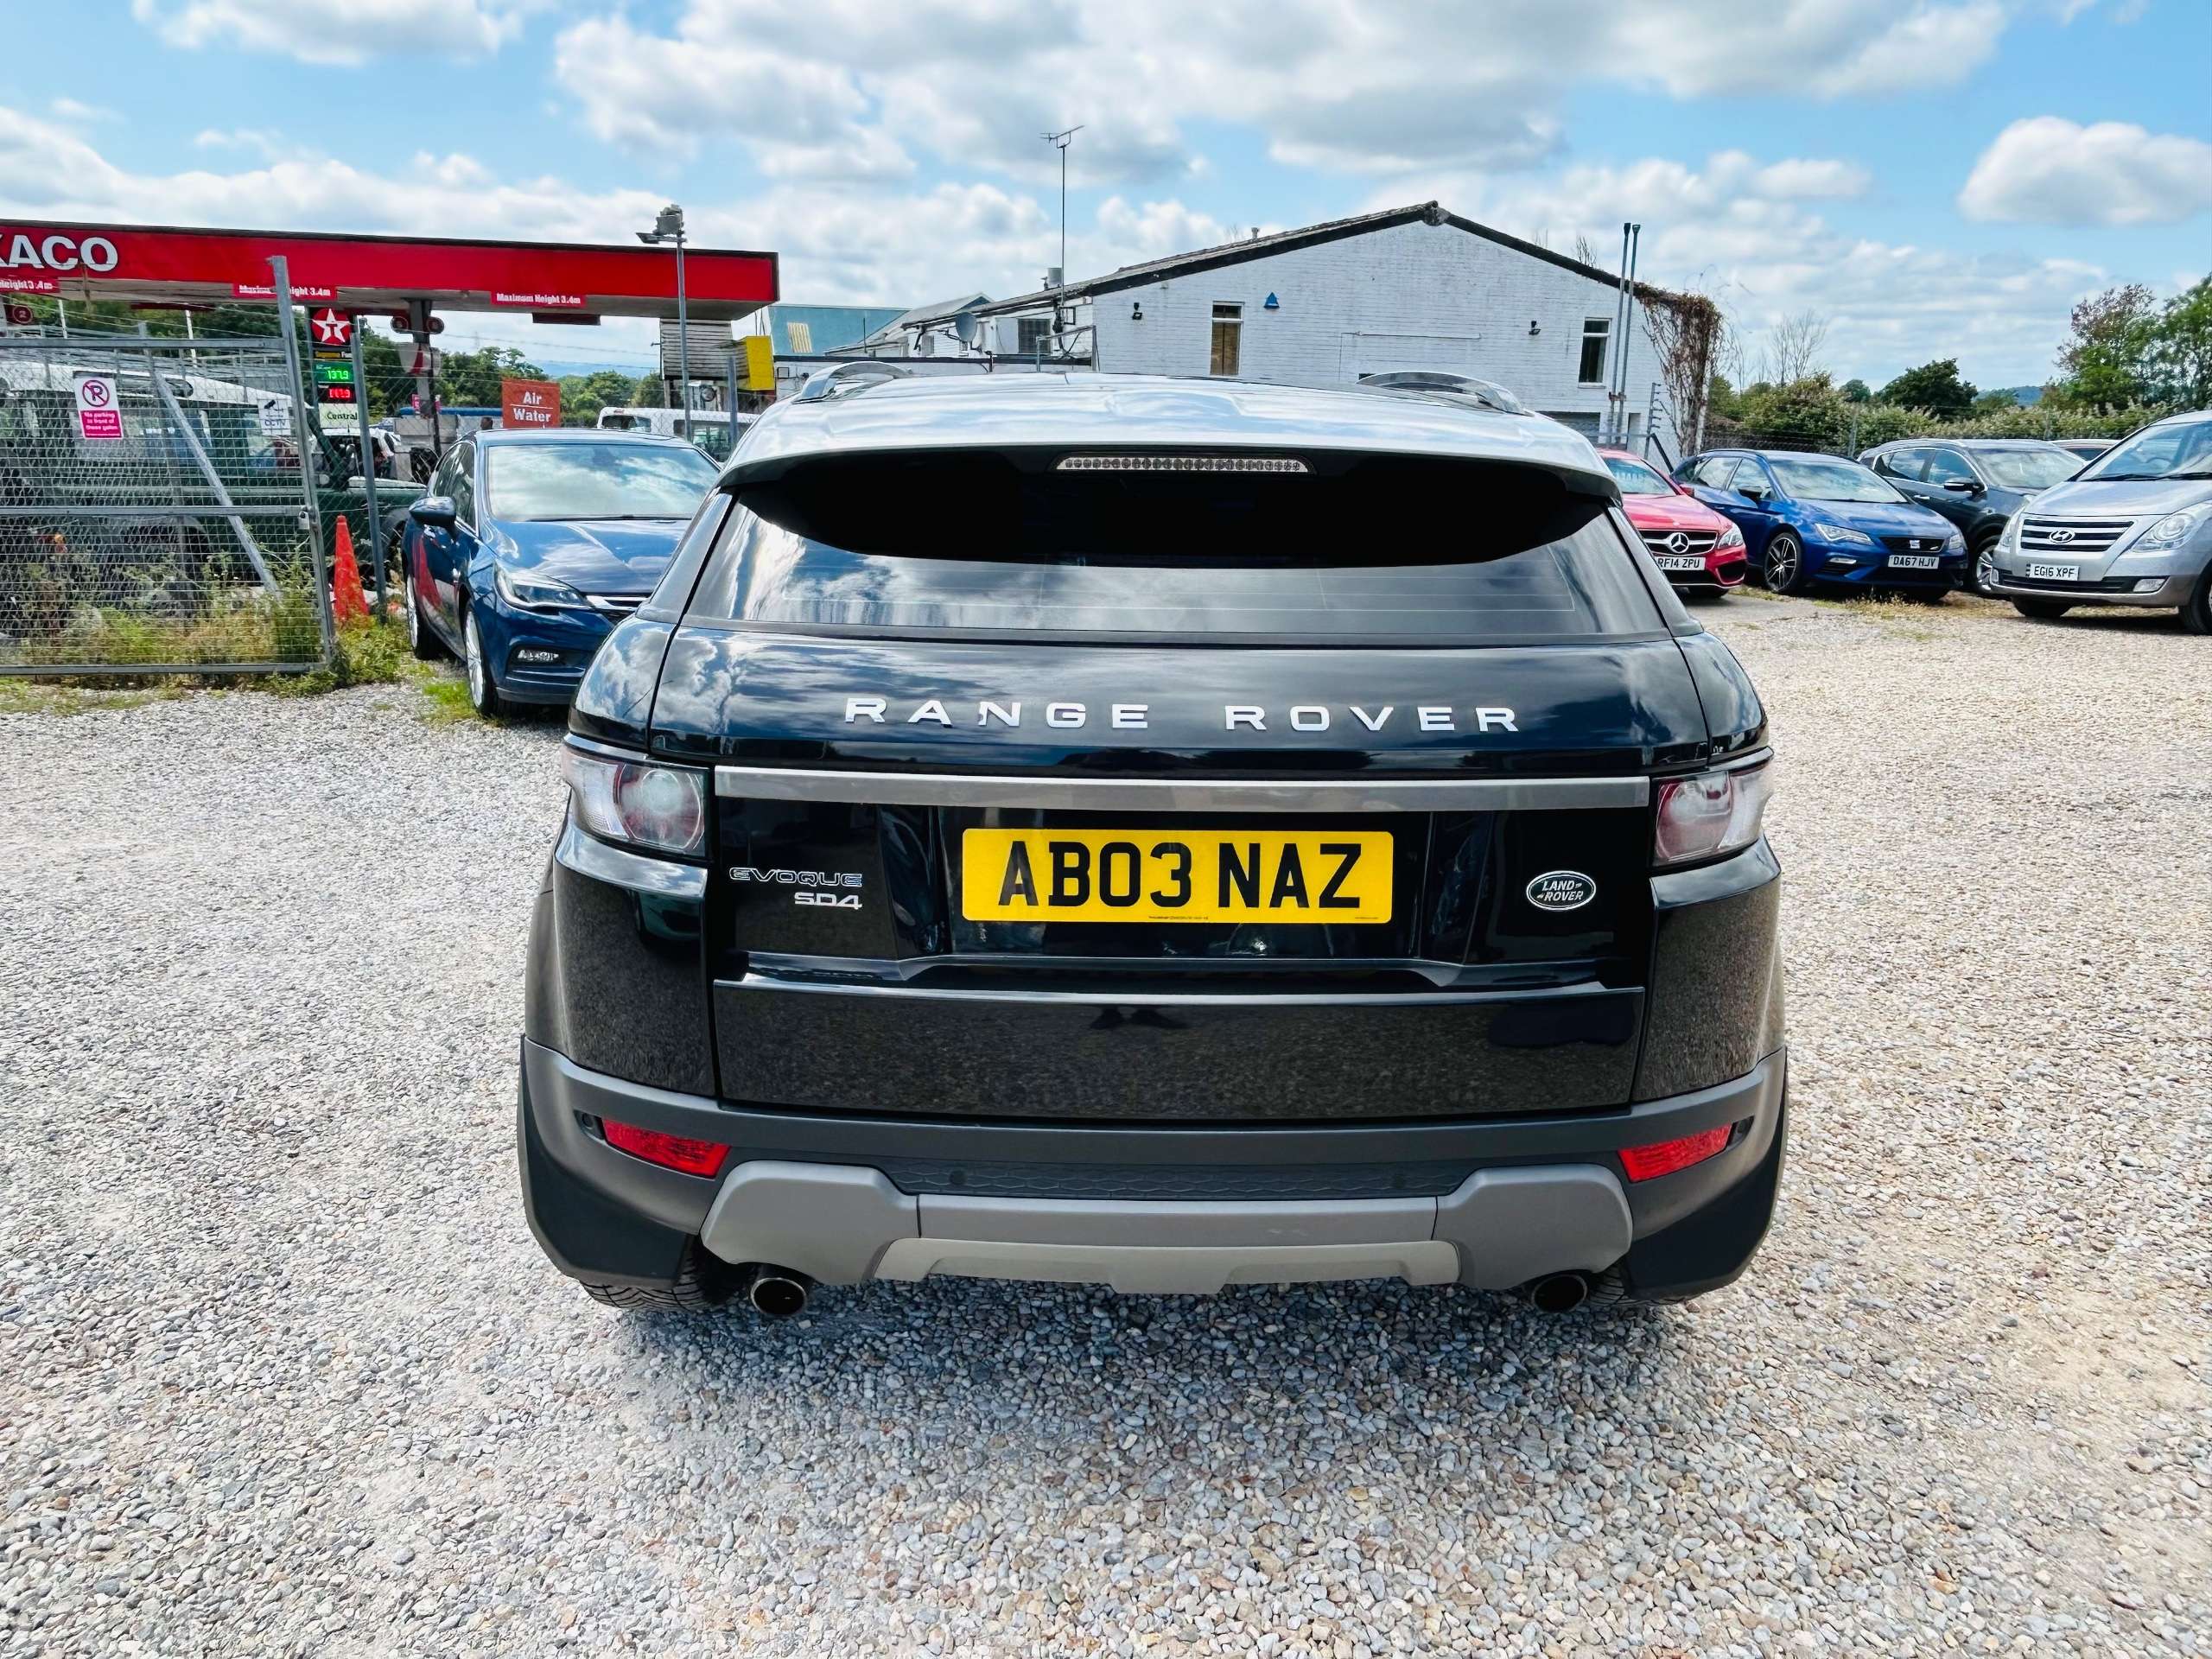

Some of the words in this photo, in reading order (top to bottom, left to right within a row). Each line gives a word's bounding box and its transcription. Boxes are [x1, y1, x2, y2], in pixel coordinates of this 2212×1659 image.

[0, 234, 118, 272] ACO
[534, 294, 560, 304] Height
[561, 296, 581, 304] 3.4m
[522, 391, 543, 405] Air
[327, 412, 359, 421] Central
[512, 408, 552, 423] Water
[1657, 557, 1679, 568] RF14
[1681, 558, 1700, 569] ZPU
[2034, 565, 2054, 577] EG16
[2056, 567, 2075, 578] XPF
[844, 697, 1148, 728] RANGE
[1224, 705, 1519, 732] ROVER
[729, 867, 862, 887] EVOQUE
[1217, 842, 1363, 909] NAZ
[1541, 880, 1575, 892] LAND
[794, 892, 862, 910] SD4
[1543, 890, 1584, 901] ROVER
